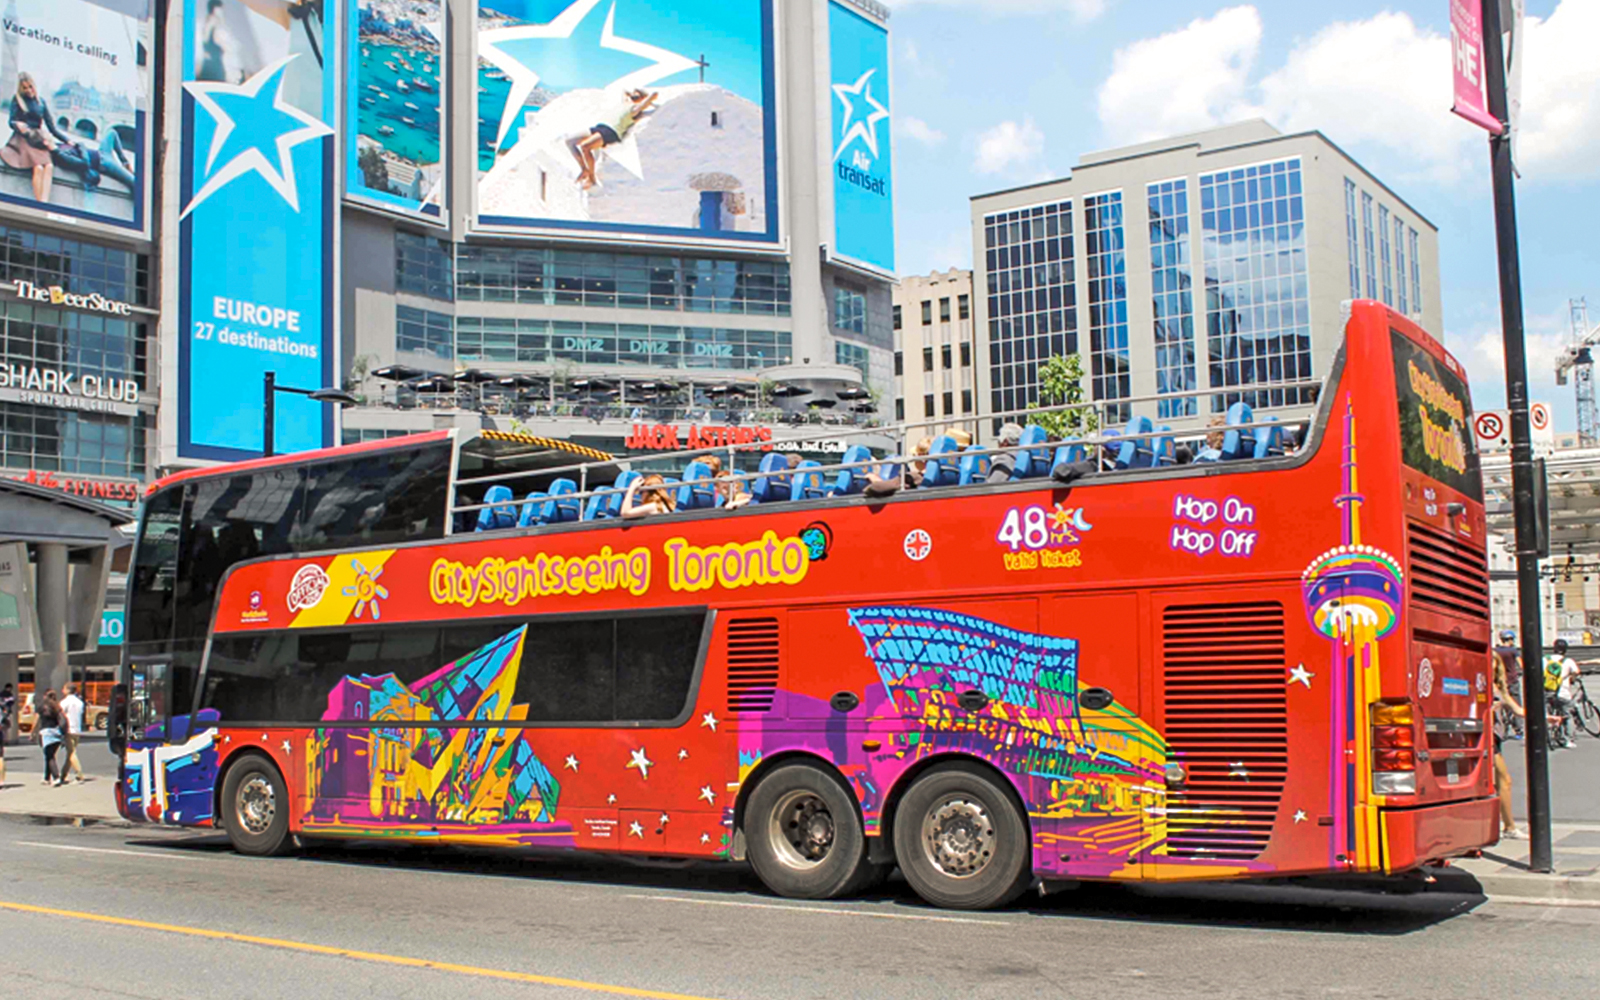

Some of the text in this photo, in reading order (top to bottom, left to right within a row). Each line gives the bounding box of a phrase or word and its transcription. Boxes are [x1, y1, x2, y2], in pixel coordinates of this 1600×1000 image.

[3, 18, 117, 66] Vacation is calling
[852, 150, 870, 171] Air
[838, 159, 885, 197] transat
[213, 295, 300, 333] EUROPE
[195, 321, 318, 358] 27 destinations
[563, 337, 604, 352] DMZ
[629, 340, 669, 354] DMZ
[694, 342, 733, 357] DMZ
[0, 363, 139, 403] SHARK CLUB
[625, 424, 680, 450] JACK
[686, 426, 774, 452] ASTOR'S
[63, 479, 138, 500] FITNESS
[1174, 495, 1254, 523] Hop On
[995, 505, 1049, 550] 48
[1171, 526, 1258, 555] Hop Off
[664, 530, 809, 592] Toronto
[1003, 549, 1082, 571] Valid Ticket
[99, 618, 124, 638] 10
